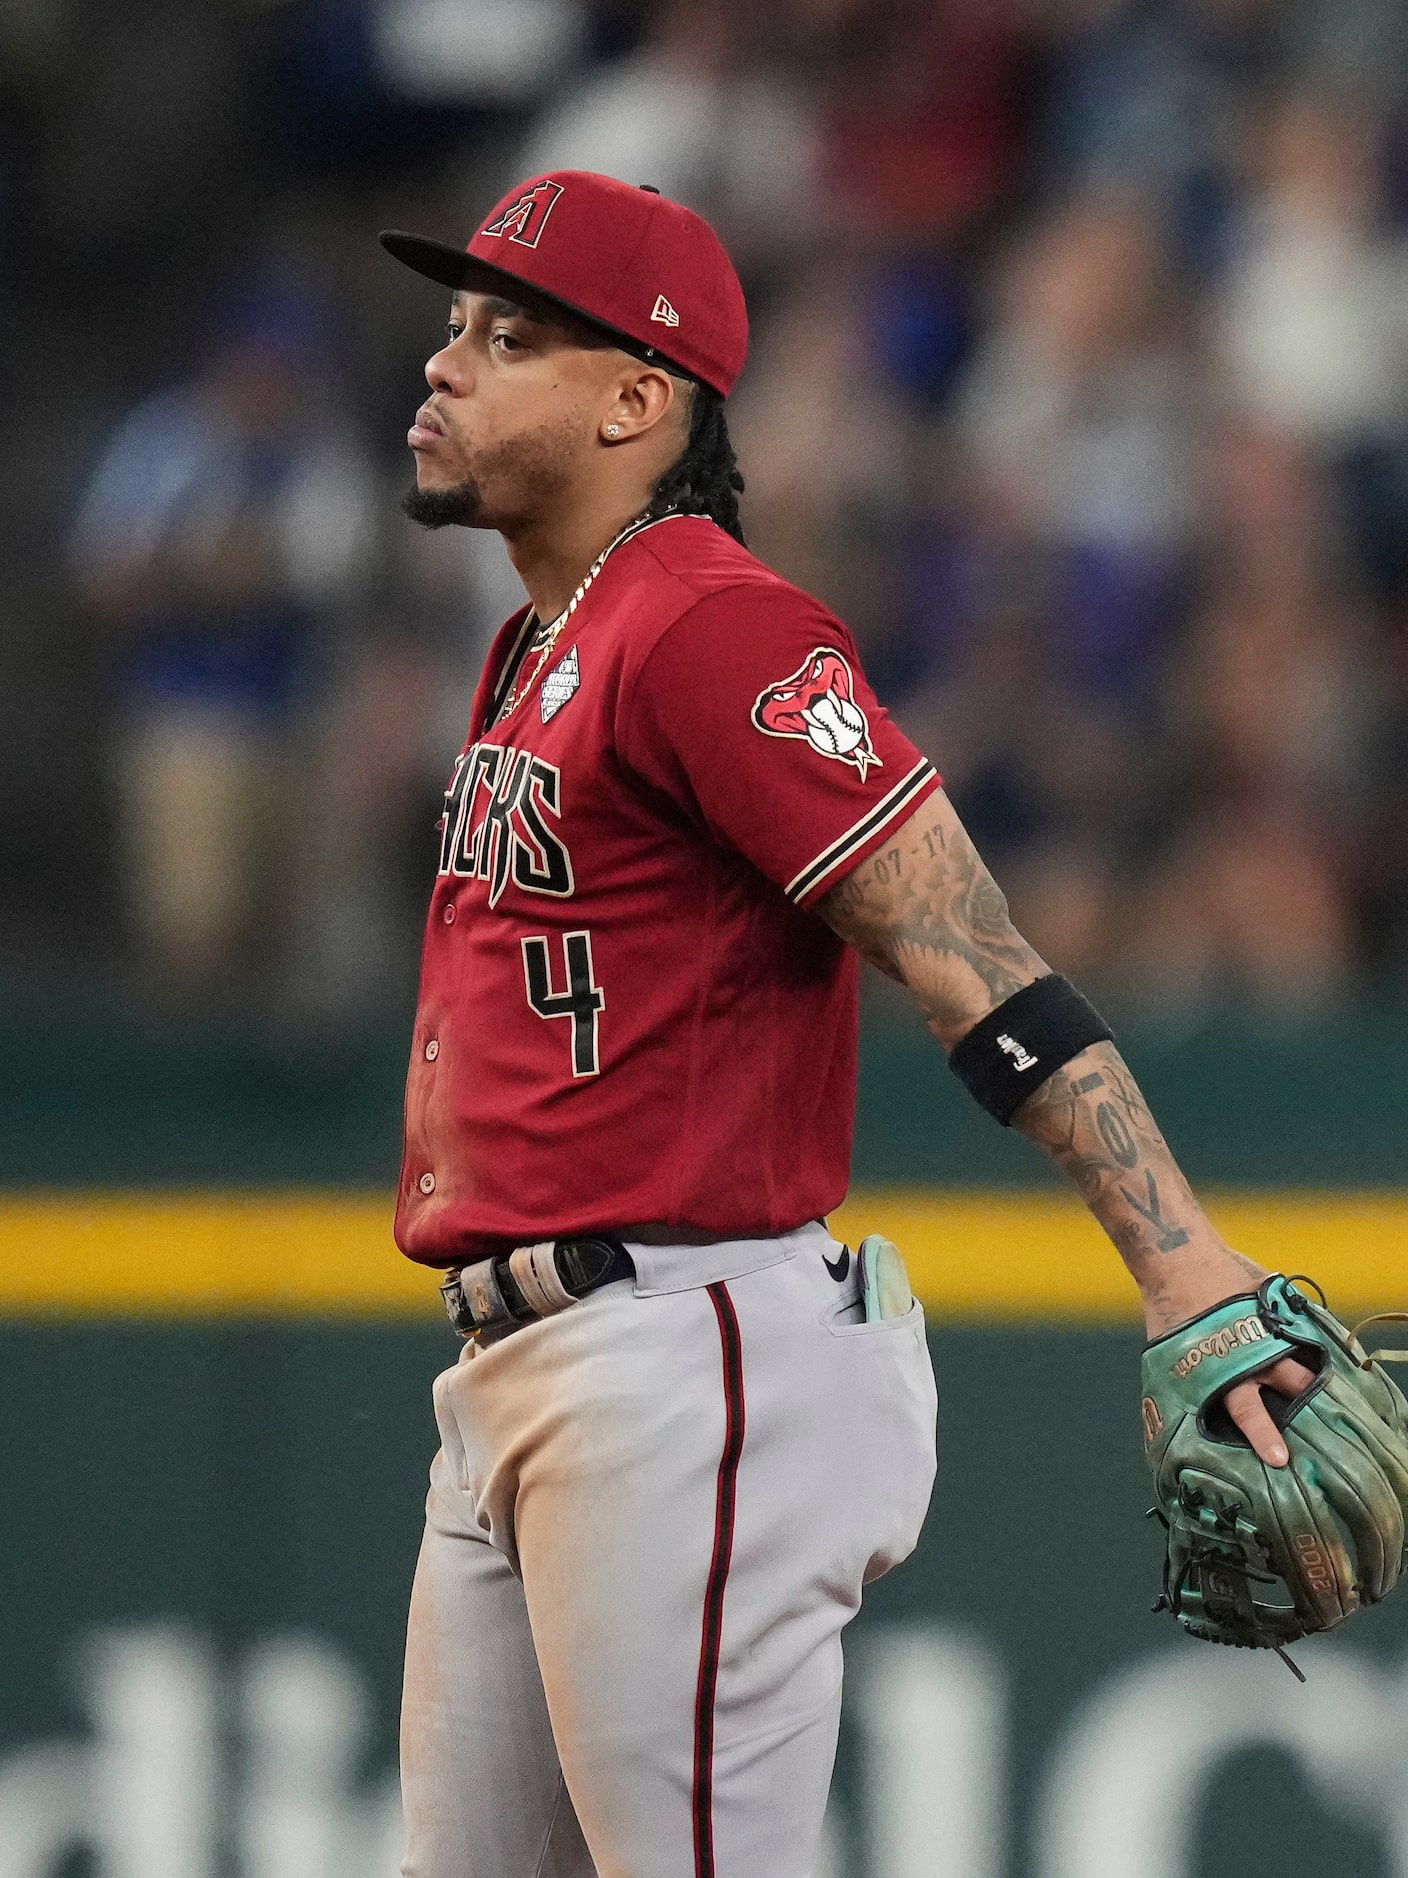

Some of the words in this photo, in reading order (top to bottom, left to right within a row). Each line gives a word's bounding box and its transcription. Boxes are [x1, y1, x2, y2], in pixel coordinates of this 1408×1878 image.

[481, 180, 564, 249] A
[521, 930, 606, 1078] 4
[1174, 1315, 1270, 1379] Wilson
